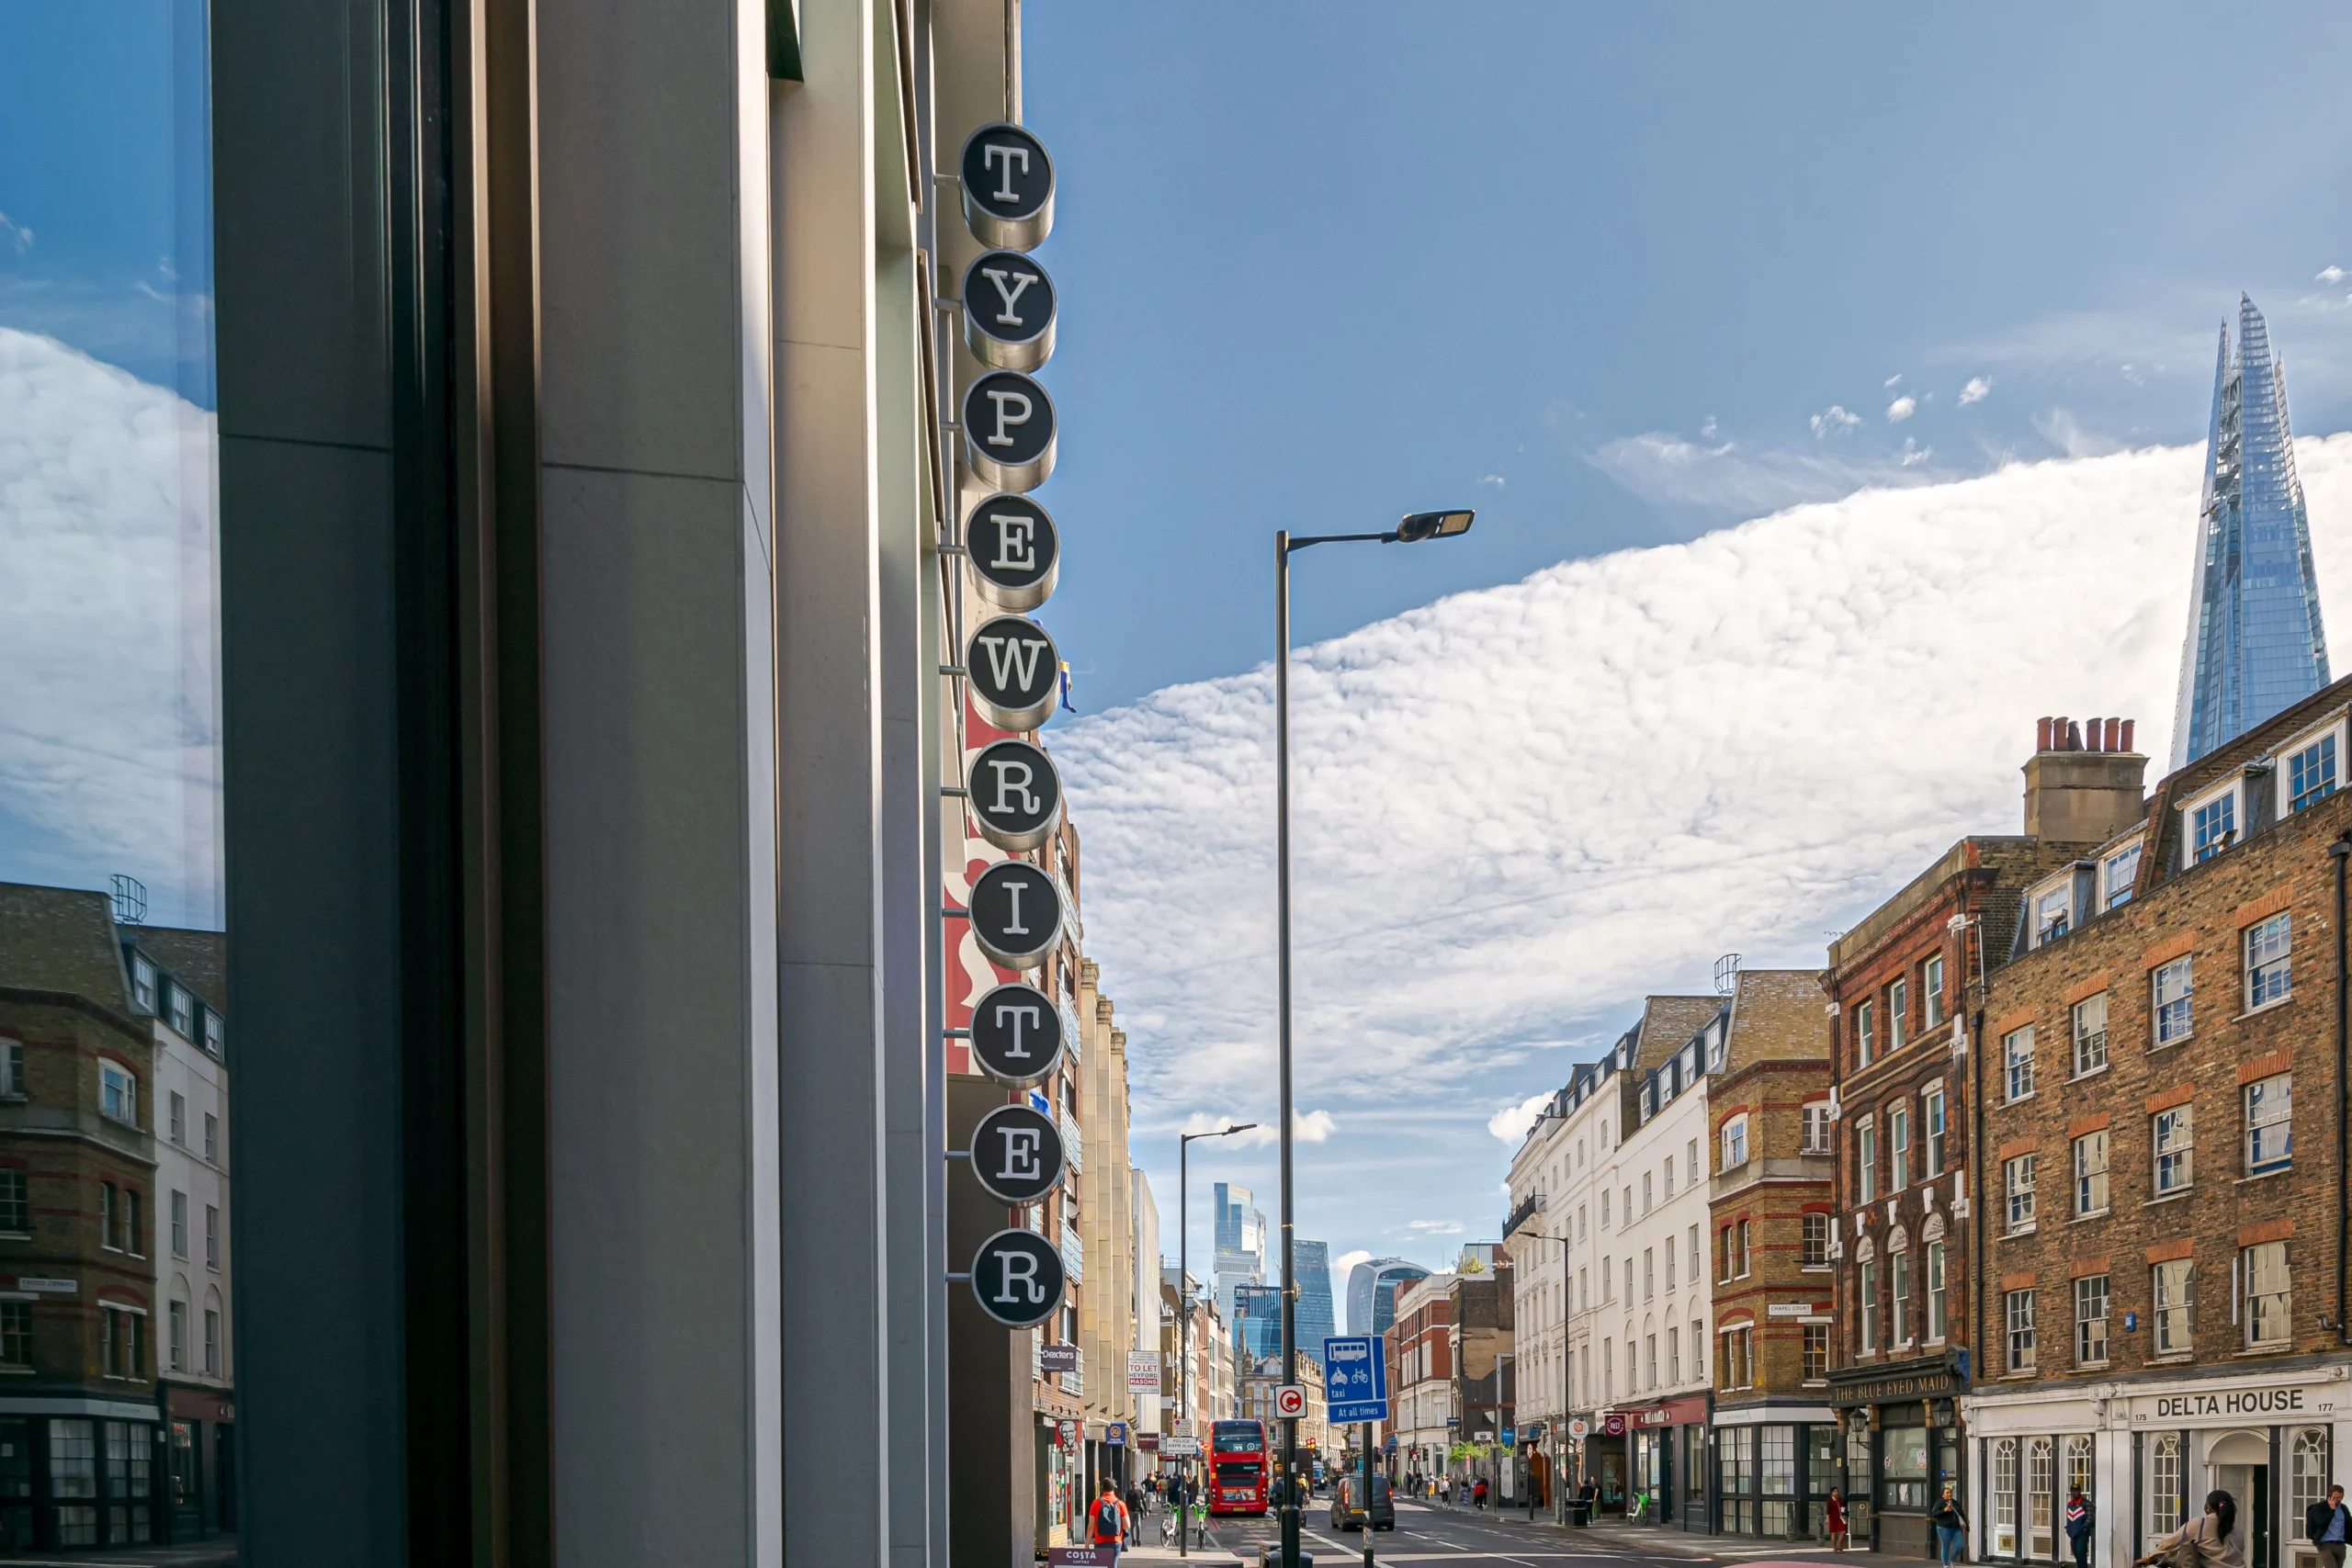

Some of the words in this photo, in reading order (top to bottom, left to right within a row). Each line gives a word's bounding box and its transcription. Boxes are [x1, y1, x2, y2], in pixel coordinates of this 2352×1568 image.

[978, 144, 1047, 1303] TYPEWRITER
[1043, 1349, 1074, 1359] Dexters
[1129, 1364, 1141, 1372] TO
[1143, 1364, 1158, 1372] LET
[1835, 1387, 1854, 1402] THE
[1858, 1383, 1883, 1399] BLUE
[1886, 1379, 1914, 1396] EYED
[1917, 1374, 1950, 1393] MAID
[1331, 1389, 1346, 1398] taxi
[2157, 1394, 2221, 1416] DELTA
[2226, 1389, 2303, 1414] HOUSE
[2317, 1403, 2334, 1412] 177
[1339, 1408, 1347, 1417] At
[1349, 1407, 1358, 1416] all
[1360, 1406, 1379, 1416] times
[2134, 1414, 2147, 1422] 175
